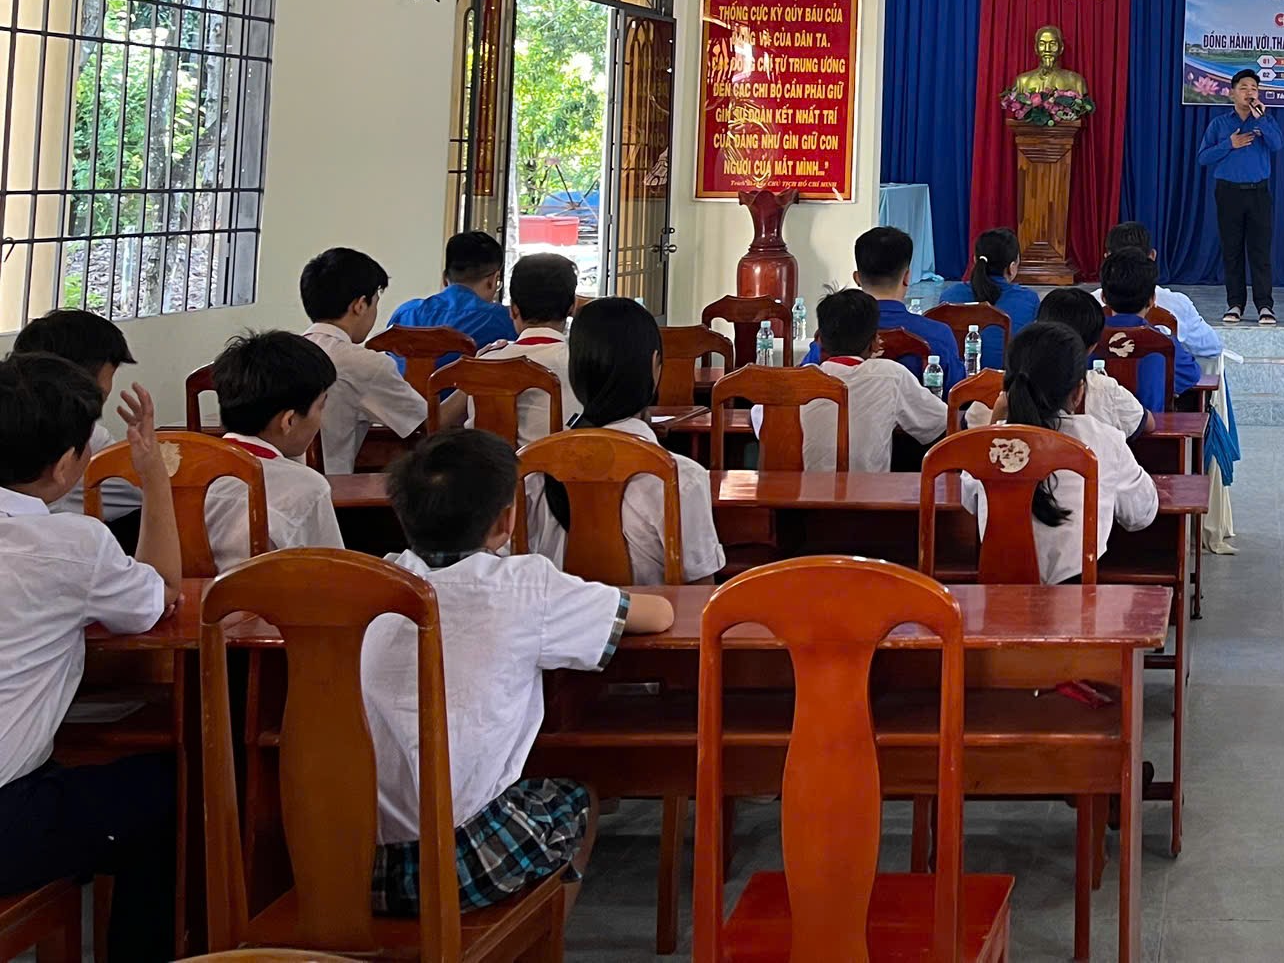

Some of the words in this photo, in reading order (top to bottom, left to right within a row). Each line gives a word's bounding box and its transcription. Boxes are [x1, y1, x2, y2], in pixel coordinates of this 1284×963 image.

[719, 0, 748, 21] THỐNG
[805, 4, 823, 22] BÁU
[825, 3, 843, 23] CỦA
[774, 27, 791, 46] CỦA
[794, 30, 813, 47] DÂN
[1230, 33, 1253, 49] HÀNH
[1255, 33, 1270, 50] VỚI
[789, 58, 818, 73] TRUNG
[820, 56, 845, 74] ƯƠNG
[753, 83, 768, 97] CHI
[770, 80, 782, 102] BỘ
[804, 79, 825, 99] PHẢI
[827, 81, 844, 99] GIỮ
[775, 104, 793, 124] KẾT
[795, 104, 820, 124] NHẤT
[823, 106, 838, 124] TRÍ
[761, 132, 780, 149] NHƯ
[783, 131, 798, 149] GÌN
[801, 132, 818, 149] GIỮ
[820, 135, 838, 150] CON
[775, 155, 793, 175] MẮT
